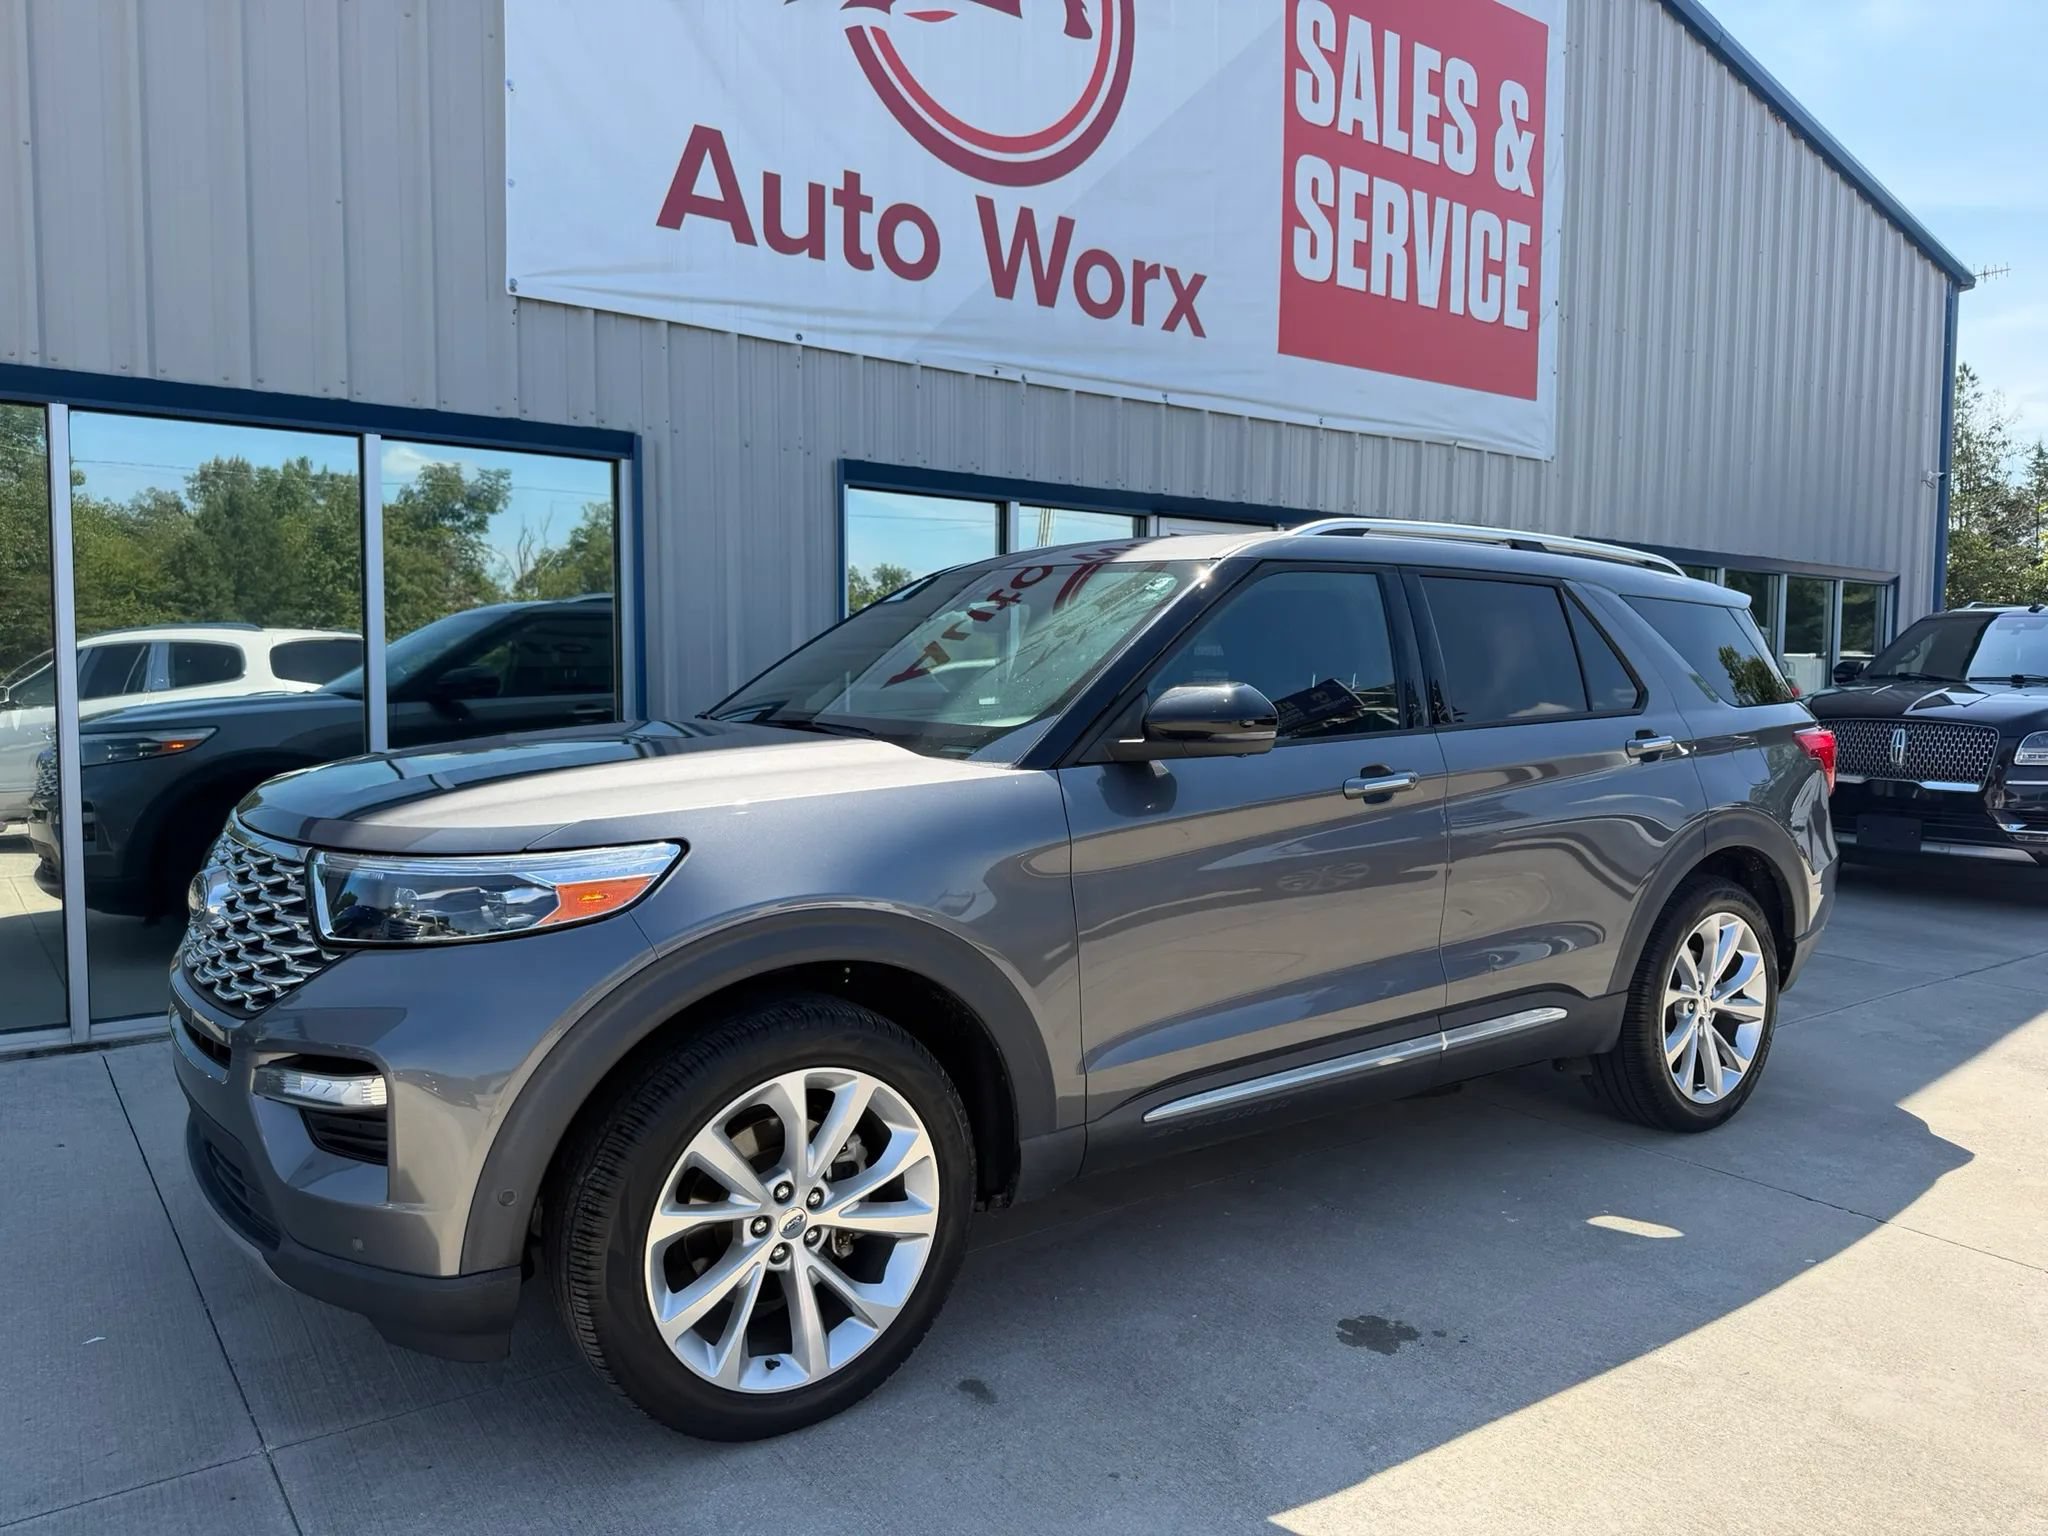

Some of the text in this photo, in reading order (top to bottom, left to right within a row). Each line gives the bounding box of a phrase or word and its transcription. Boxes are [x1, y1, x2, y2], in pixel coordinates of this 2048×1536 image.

[1295, 0, 1536, 197] SALES &
[656, 124, 1207, 339] Auto Worx
[1292, 153, 1532, 332] SERVICE
